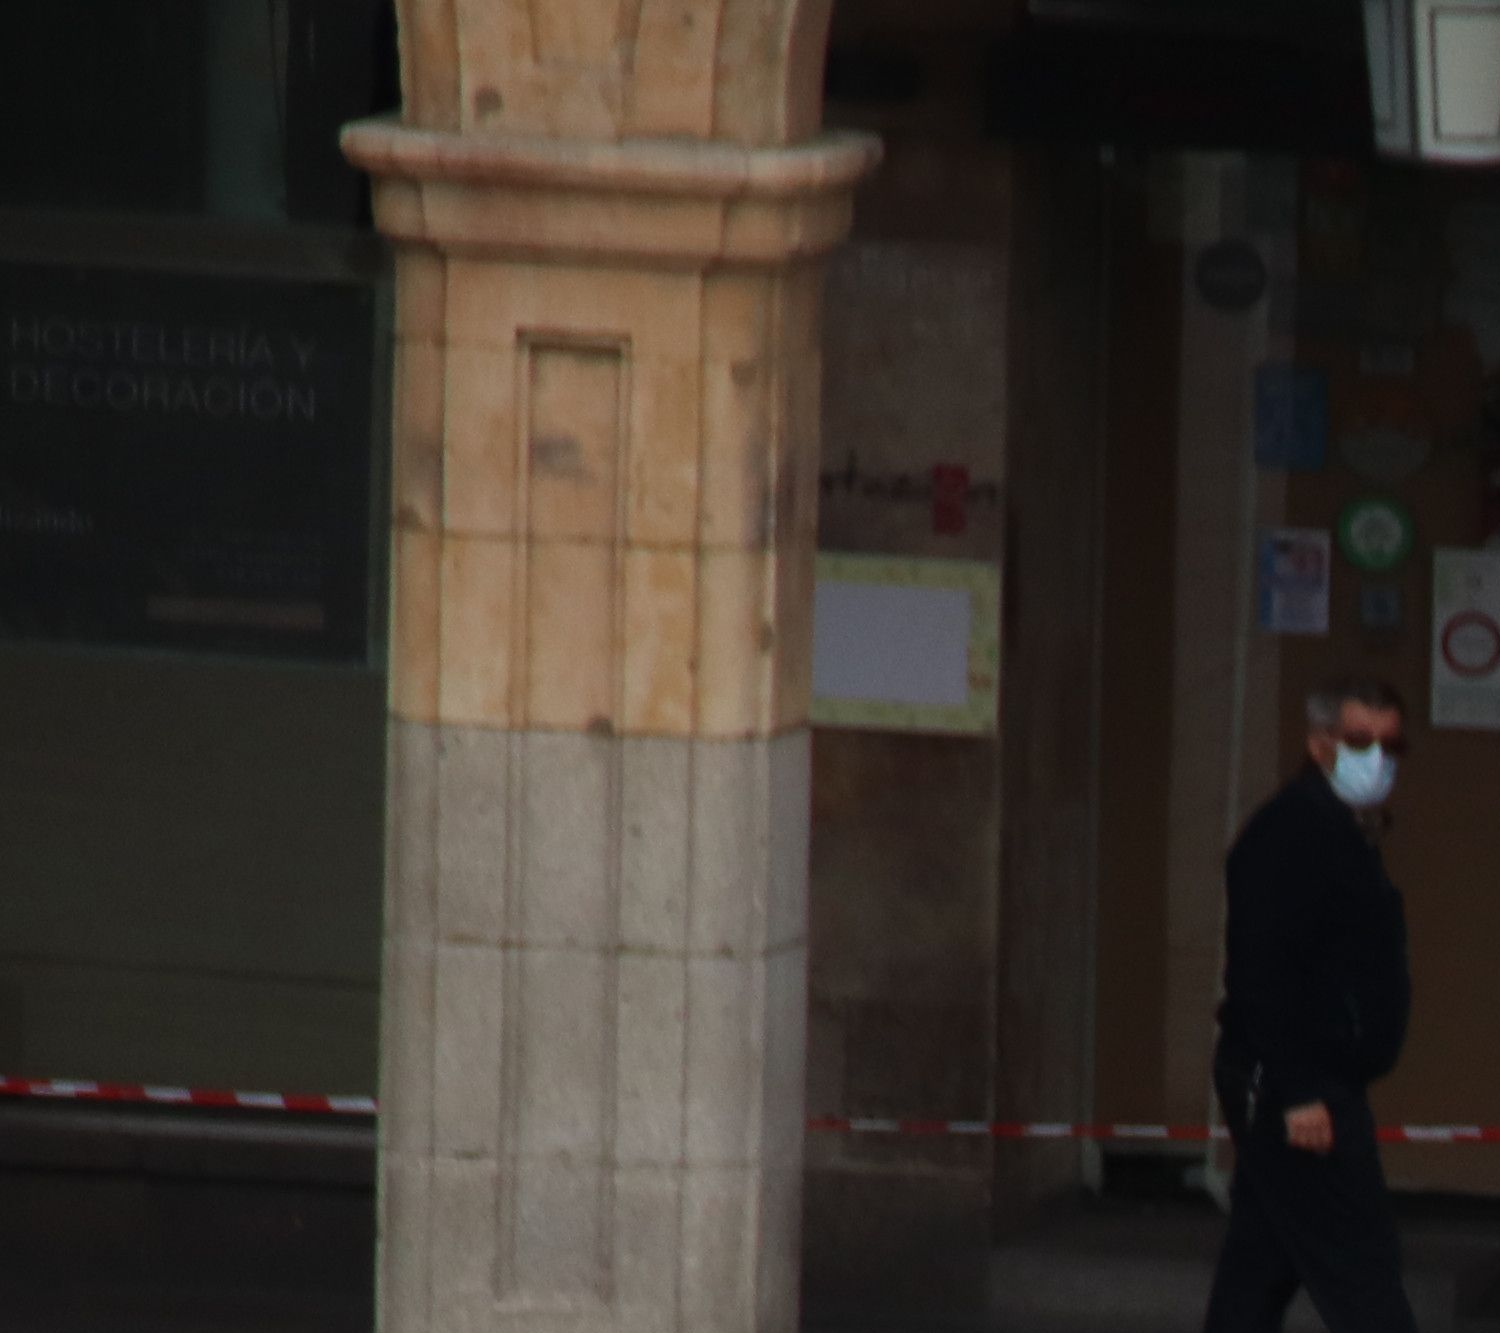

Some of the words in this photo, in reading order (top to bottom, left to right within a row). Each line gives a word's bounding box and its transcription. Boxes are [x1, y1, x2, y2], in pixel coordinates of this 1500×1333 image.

[10, 314, 273, 366] HOSTELERÍA
[289, 325, 317, 372] Y
[9, 362, 317, 422] DECORACIÓN
